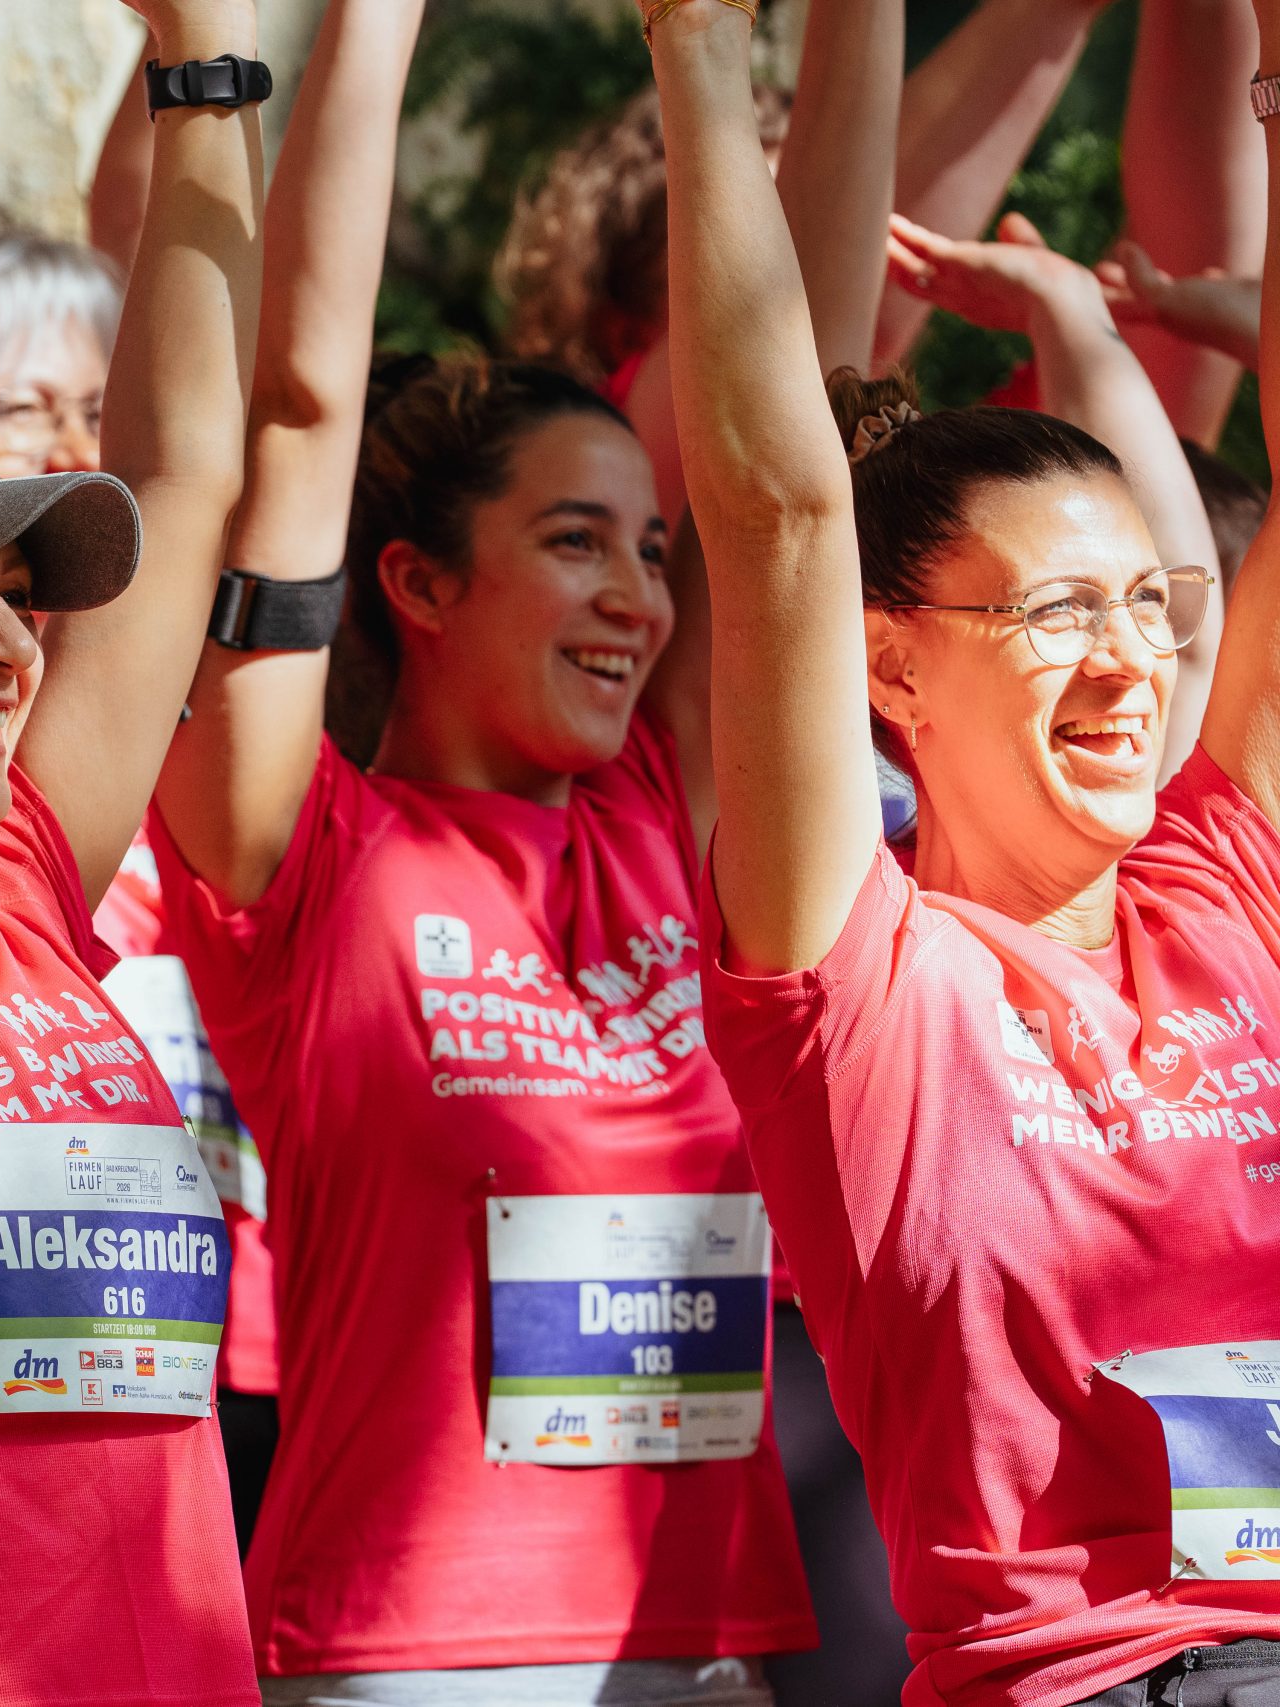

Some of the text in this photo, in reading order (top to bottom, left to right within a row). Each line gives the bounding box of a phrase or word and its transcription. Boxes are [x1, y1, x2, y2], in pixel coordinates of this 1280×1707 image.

[430, 1028, 508, 1062] ALS
[31, 1081, 93, 1113] MT
[89, 1074, 150, 1106] DIR.
[431, 1072, 588, 1098] Gemeinsam
[69, 1136, 87, 1149] dm
[1012, 1114, 1132, 1155] MEHR
[69, 1162, 102, 1172] FIRMEN
[106, 1164, 139, 1173] BAD KREUZNACH
[1245, 1162, 1280, 1183] #ge
[70, 1175, 102, 1190] LAUF
[103, 1286, 146, 1316] 616
[579, 1281, 717, 1335] Denise
[93, 1323, 126, 1335] STARTZEIT
[144, 1324, 157, 1335] UHR
[13, 1349, 59, 1379] dm
[97, 1359, 123, 1369] 88.3
[136, 1350, 154, 1358] SCHUH
[162, 1356, 208, 1371] BIONTECH
[631, 1345, 673, 1375] 103
[1235, 1363, 1271, 1371] FIRMEN
[1242, 1372, 1276, 1384] LAUF
[545, 1407, 586, 1433] dm
[1236, 1518, 1280, 1549] dm
